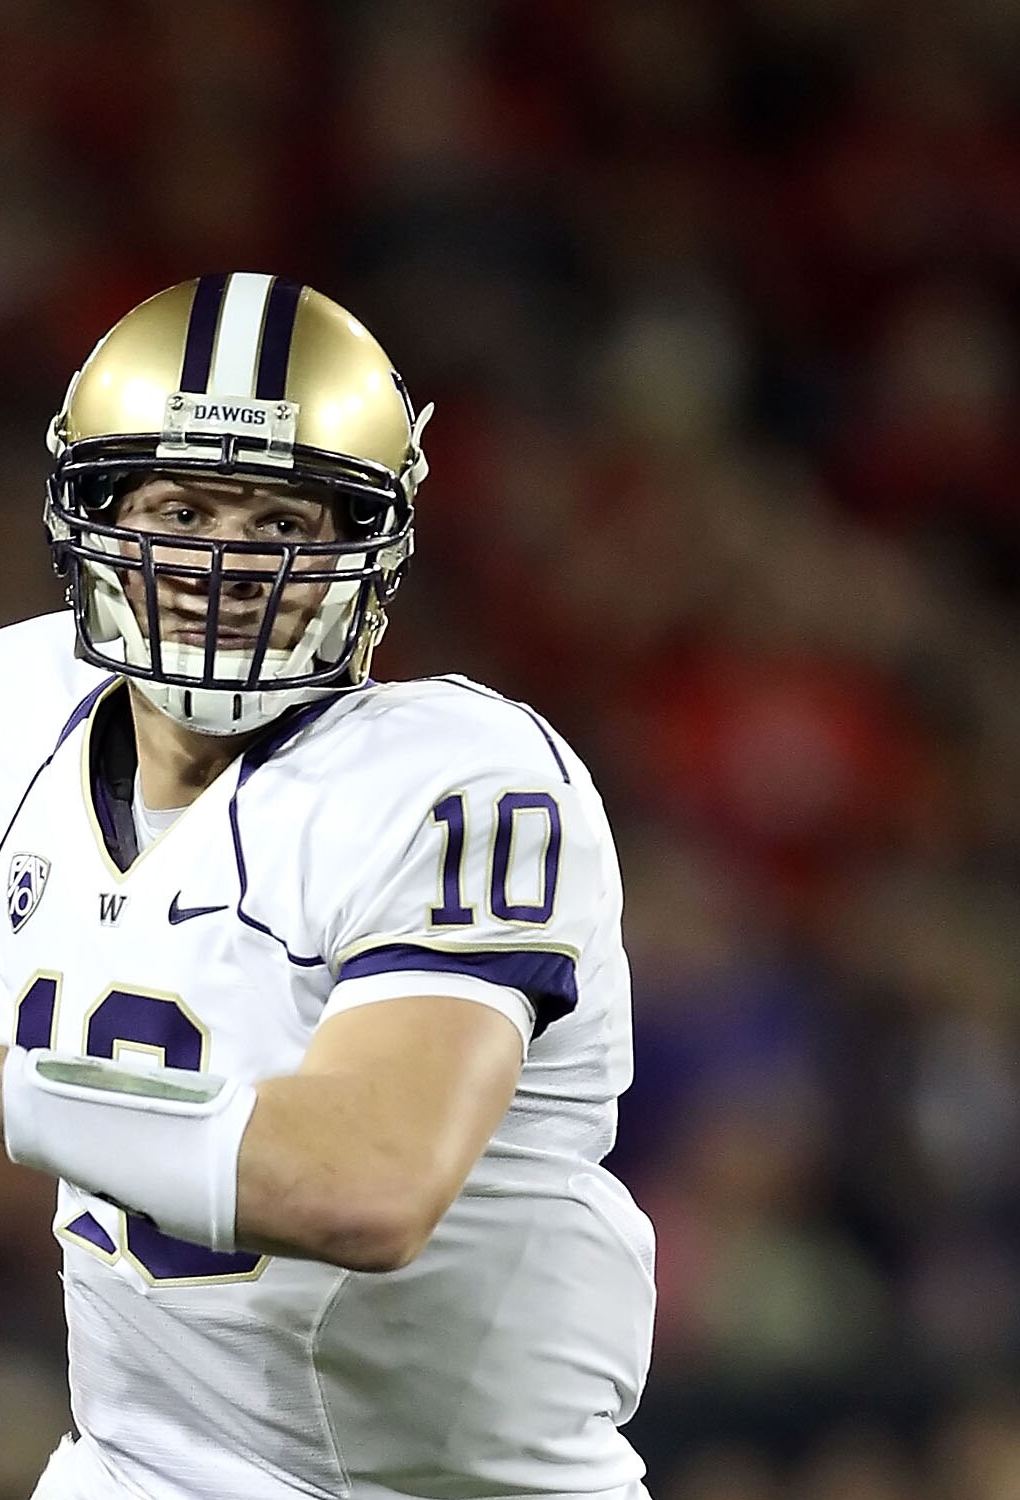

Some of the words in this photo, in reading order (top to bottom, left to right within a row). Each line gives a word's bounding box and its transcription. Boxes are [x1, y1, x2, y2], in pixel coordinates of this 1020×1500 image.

[194, 404, 266, 425] DAWGS
[428, 788, 563, 929] 10
[99, 892, 128, 927] W
